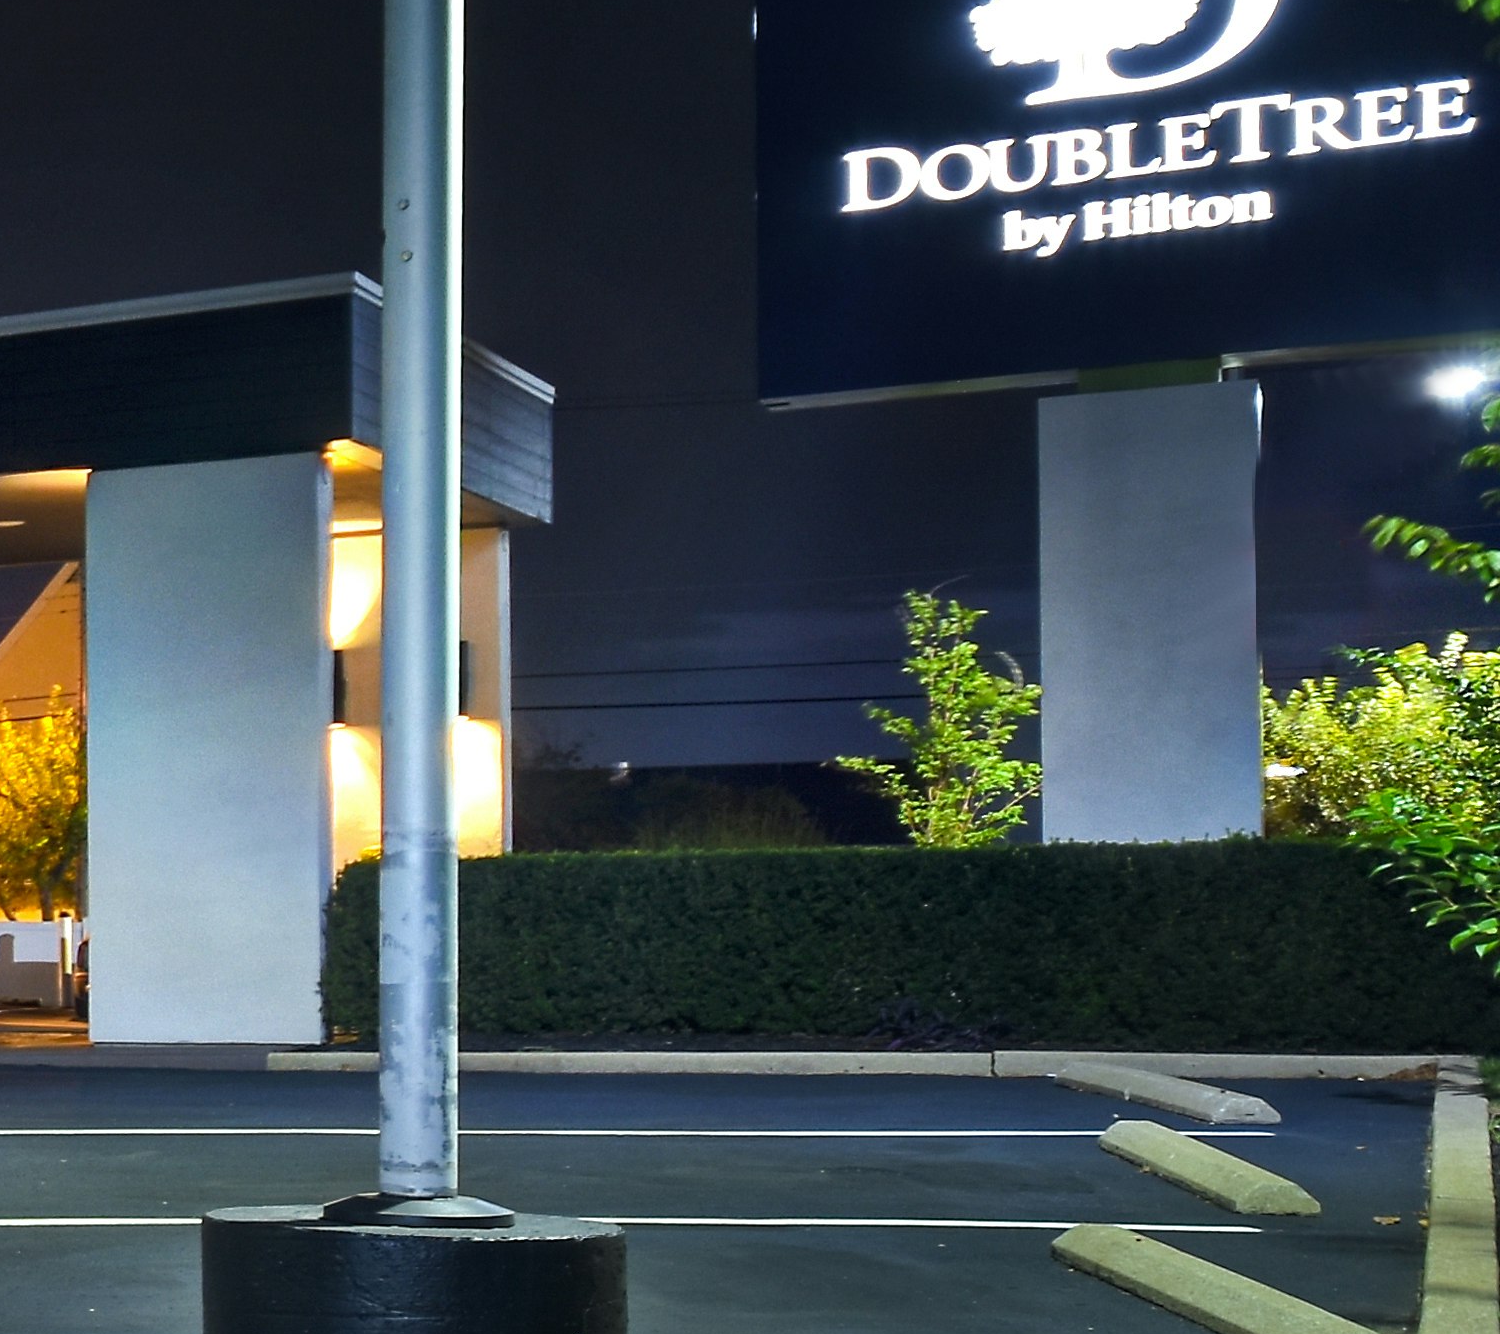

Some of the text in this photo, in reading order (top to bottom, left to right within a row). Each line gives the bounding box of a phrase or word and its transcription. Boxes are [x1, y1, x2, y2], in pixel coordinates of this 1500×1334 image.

[840, 78, 1477, 213] DOUBLETREE
[1002, 187, 1274, 258] by Hilton
